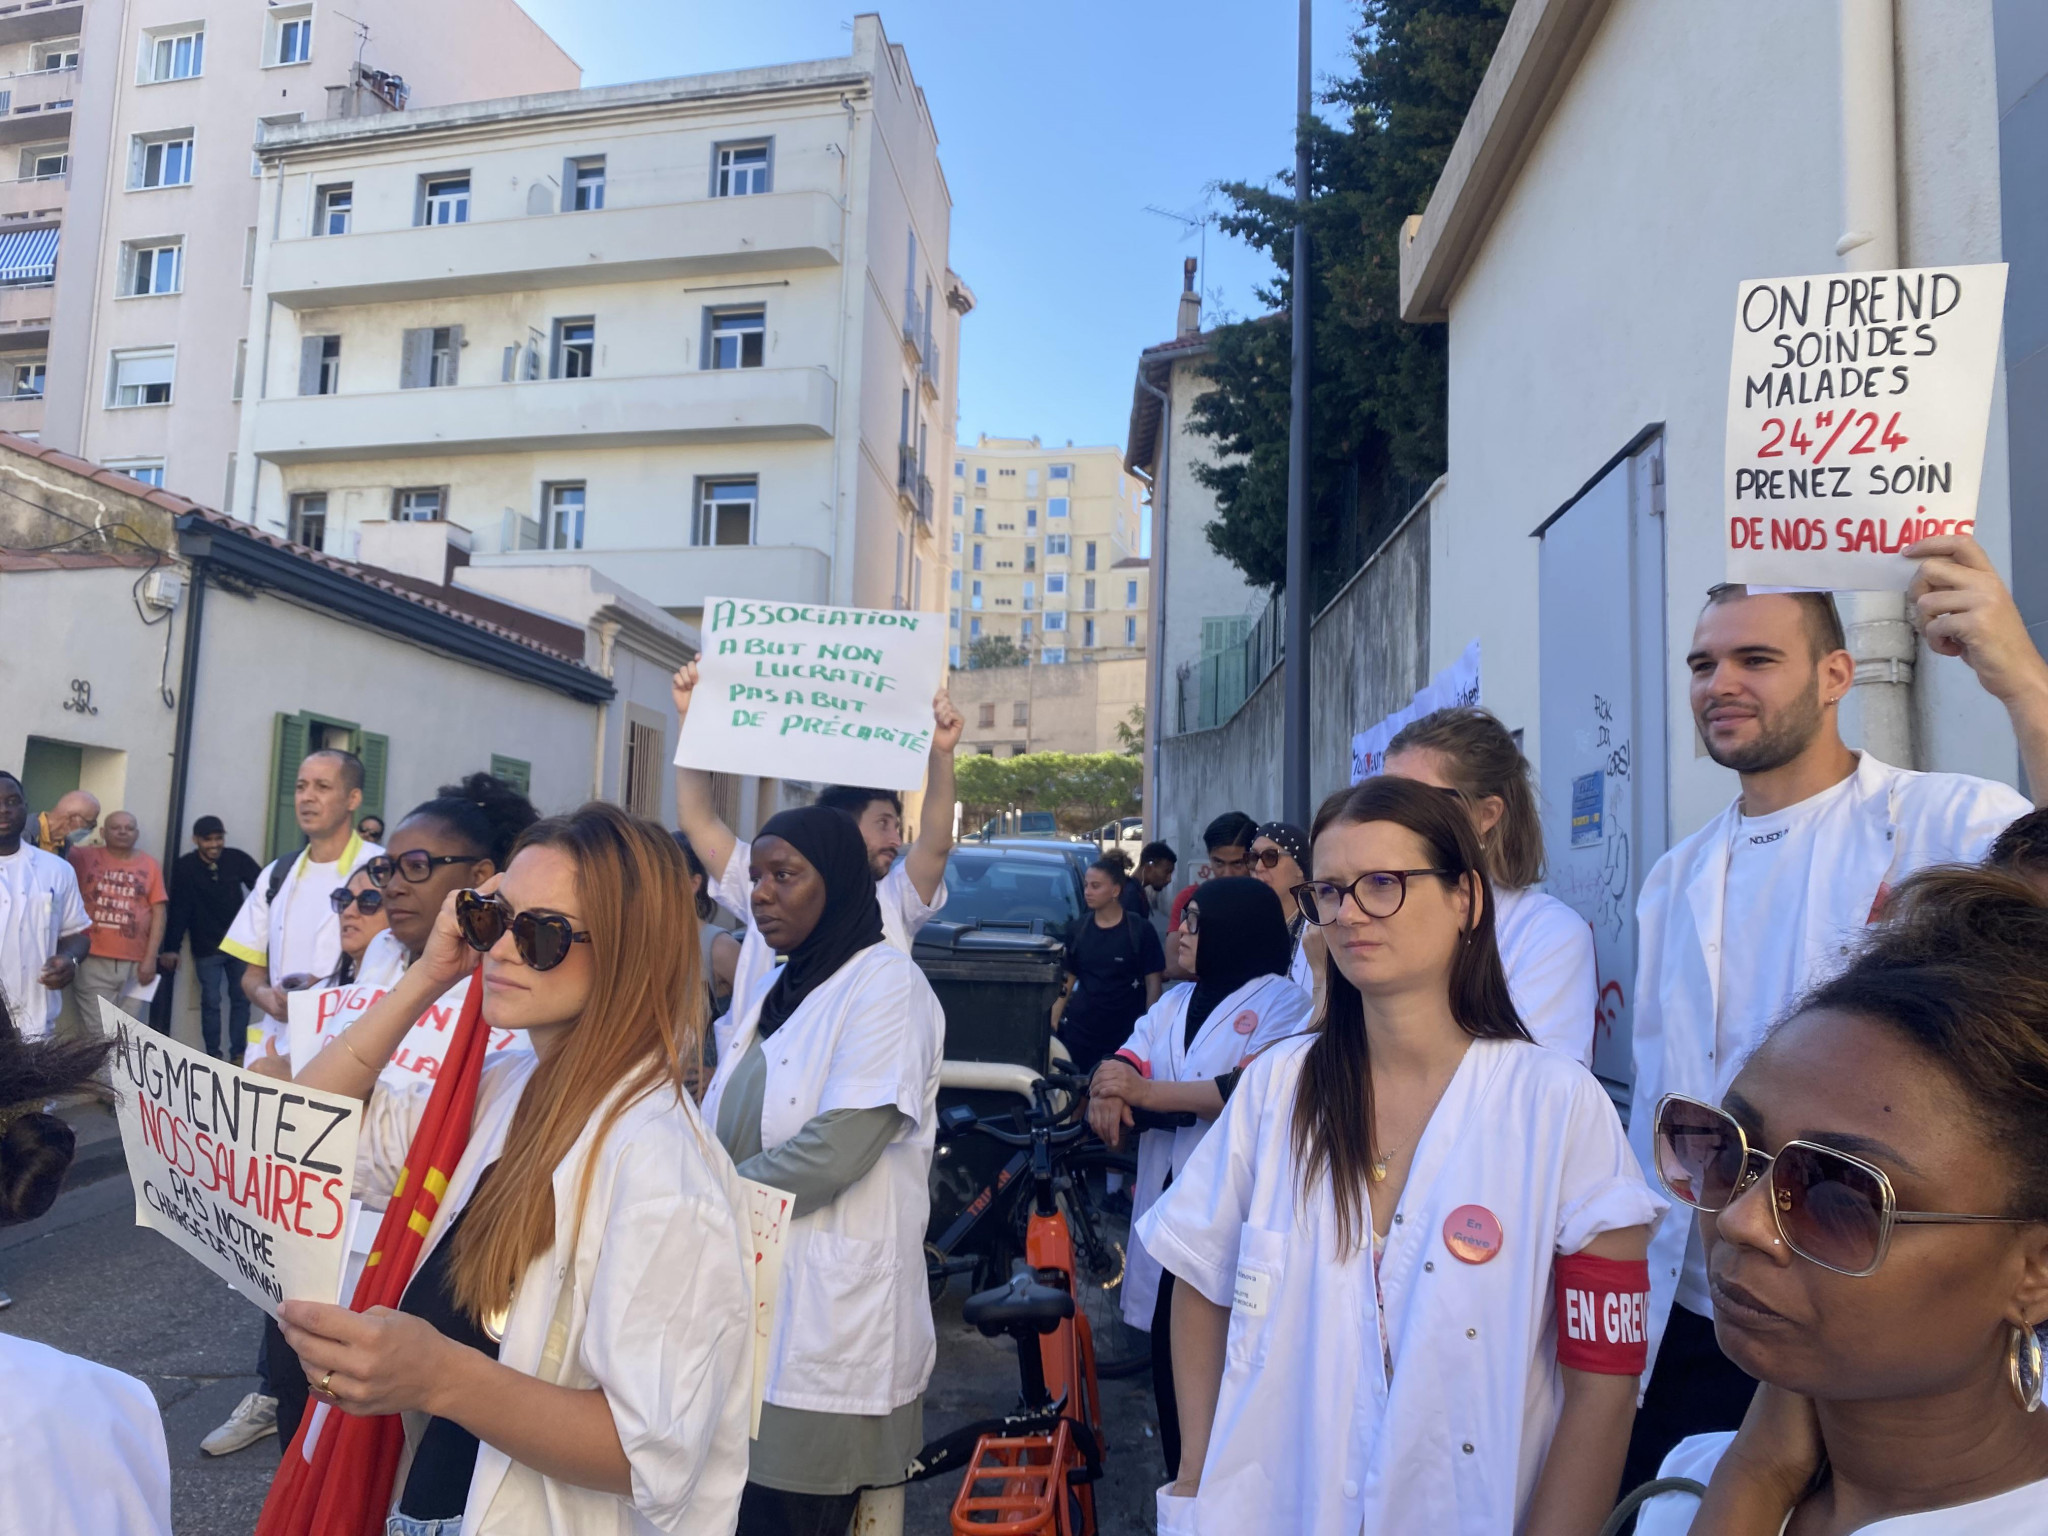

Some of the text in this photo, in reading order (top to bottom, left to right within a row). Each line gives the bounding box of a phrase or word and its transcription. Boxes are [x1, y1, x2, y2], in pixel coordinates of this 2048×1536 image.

[1743, 273, 1962, 332] ON PREND
[1745, 365, 1910, 409] MALADES
[1735, 466, 1853, 500] PRENEZ
[1730, 516, 1764, 550] DE
[1771, 517, 1828, 552] NOS
[711, 599, 920, 633] ASSOCIATION
[718, 638, 884, 666] A BUT NON
[755, 661, 897, 694] LUCRATIF
[729, 683, 868, 713] PAS A BUT
[731, 709, 768, 727] DE
[116, 1019, 352, 1175] AUGMENTEZ
[139, 1091, 344, 1240] NOS SALAIRES
[143, 1180, 208, 1245] CHARGE
[205, 1227, 231, 1262] DE
[168, 1167, 275, 1268] PAS NOTRE
[1466, 1218, 1482, 1230] En
[1566, 1287, 1651, 1344] EN GREV
